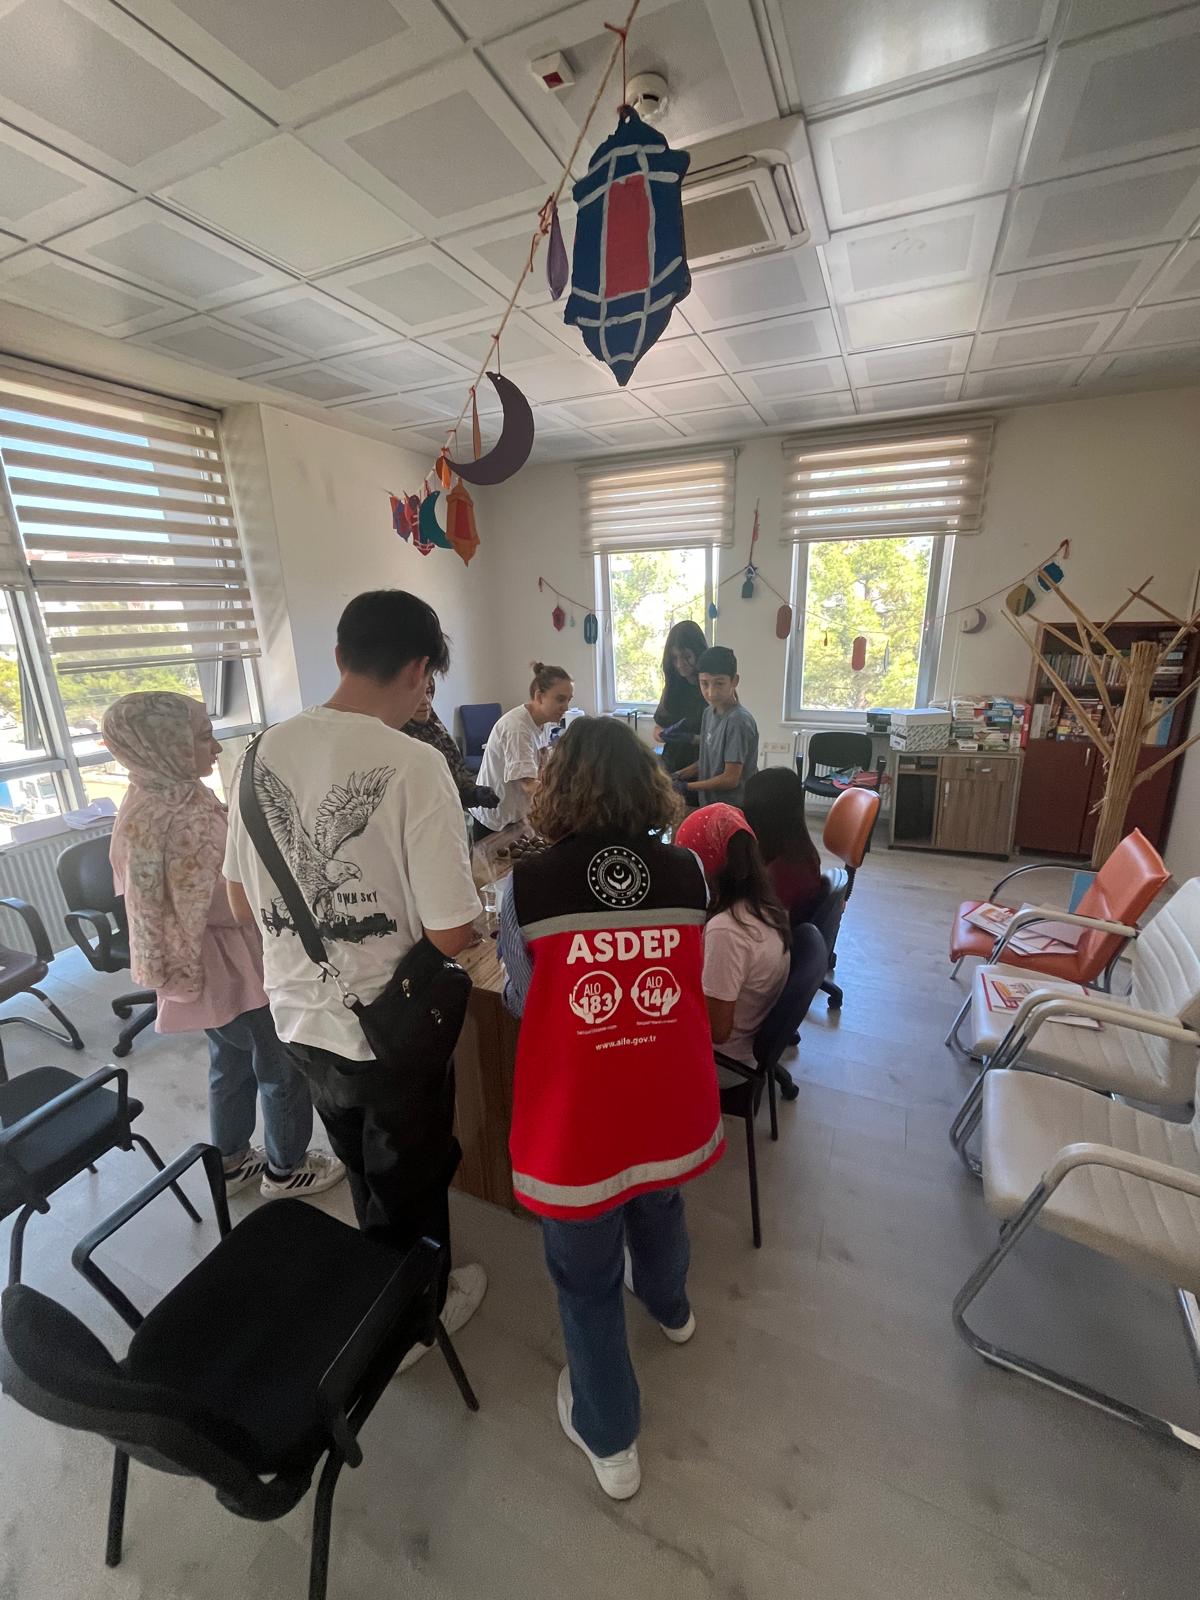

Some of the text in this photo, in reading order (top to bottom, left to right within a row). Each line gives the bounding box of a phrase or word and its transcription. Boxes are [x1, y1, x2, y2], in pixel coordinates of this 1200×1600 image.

[337, 891, 377, 905] OWN SKY
[567, 928, 681, 965] ASDEP
[584, 982, 601, 996] ALO
[646, 976, 663, 989] ALO
[579, 993, 613, 1014] 183
[641, 988, 673, 1007] 144
[595, 1035, 657, 1051] www.aile.gov.tr
